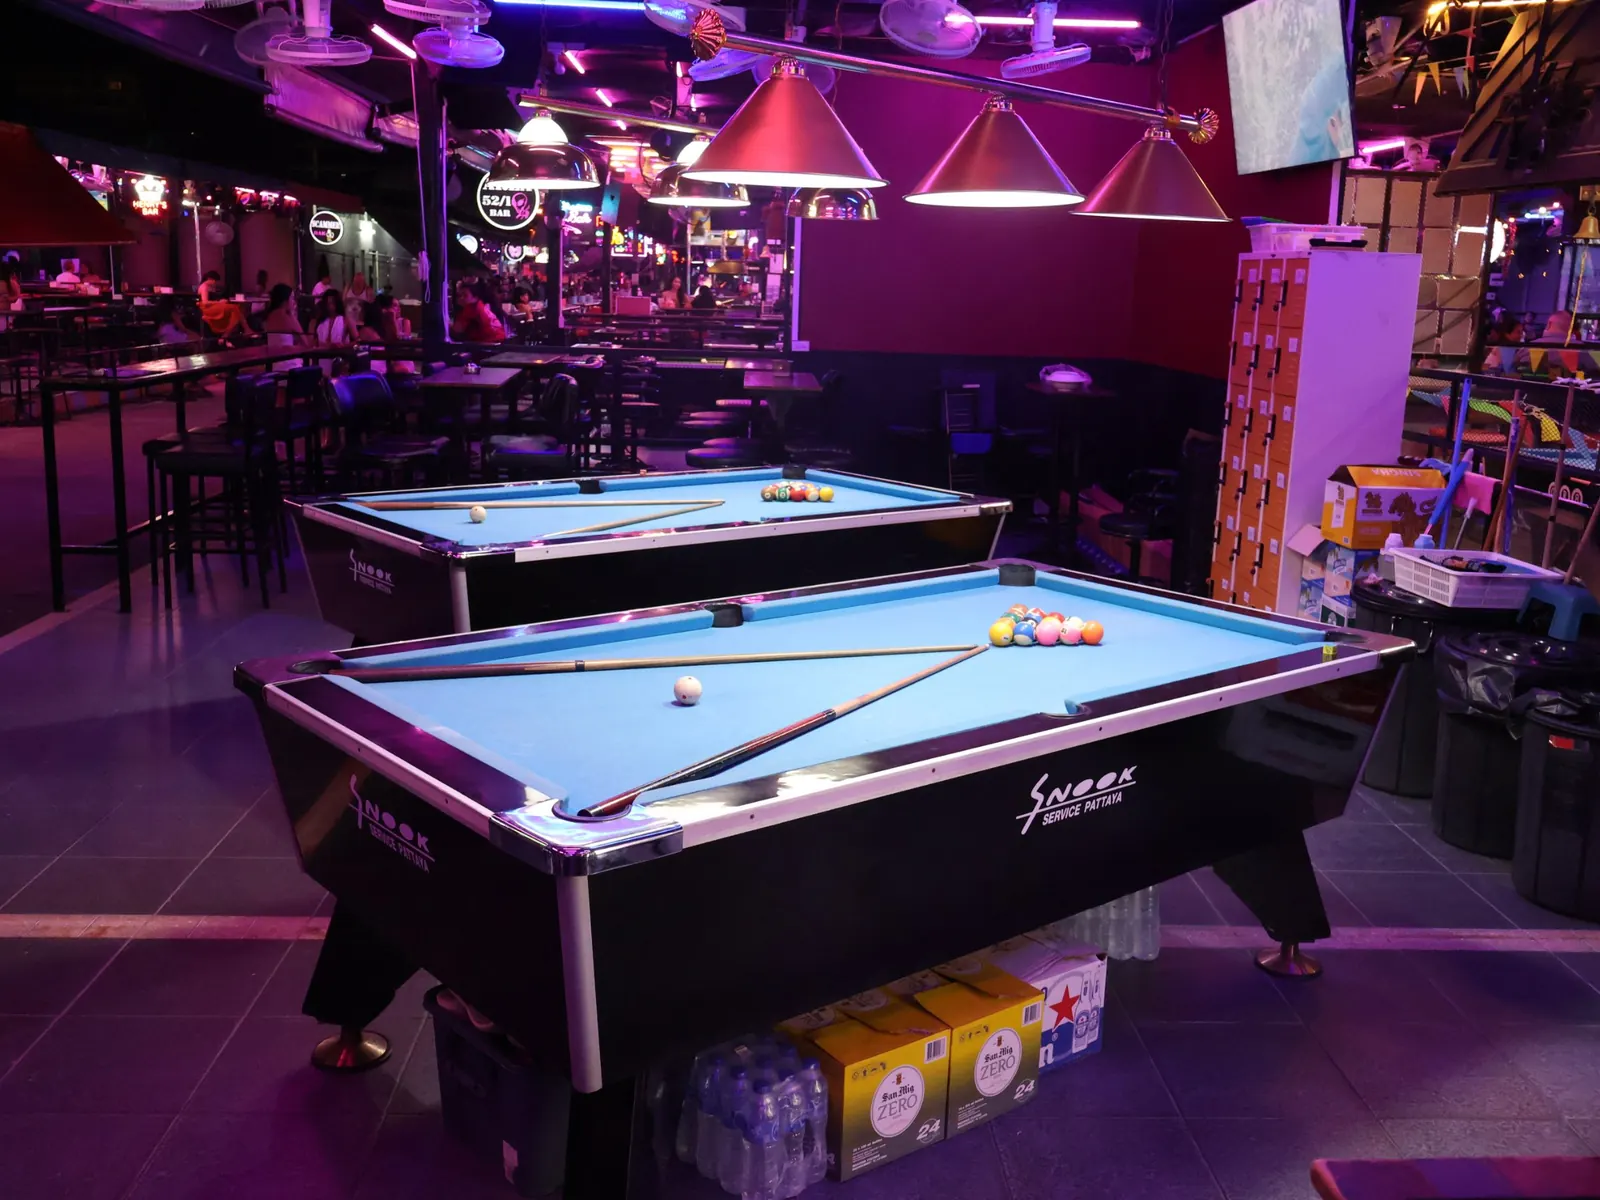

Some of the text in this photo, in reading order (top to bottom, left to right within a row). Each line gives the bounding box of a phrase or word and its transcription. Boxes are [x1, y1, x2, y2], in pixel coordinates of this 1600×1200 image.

[482, 195, 511, 207] 52/1
[489, 208, 511, 217] BAR
[1021, 765, 1138, 835] SNOOK
[1042, 791, 1123, 826] SERVICE PATTAYA
[349, 773, 430, 853] SNOOK
[984, 1045, 1013, 1063] San Mig
[980, 1055, 1016, 1081] ZERO
[881, 1083, 915, 1103] San Mig
[1013, 1079, 1035, 1100] 24
[877, 1094, 918, 1121] ZERO
[916, 1118, 941, 1141] 24
